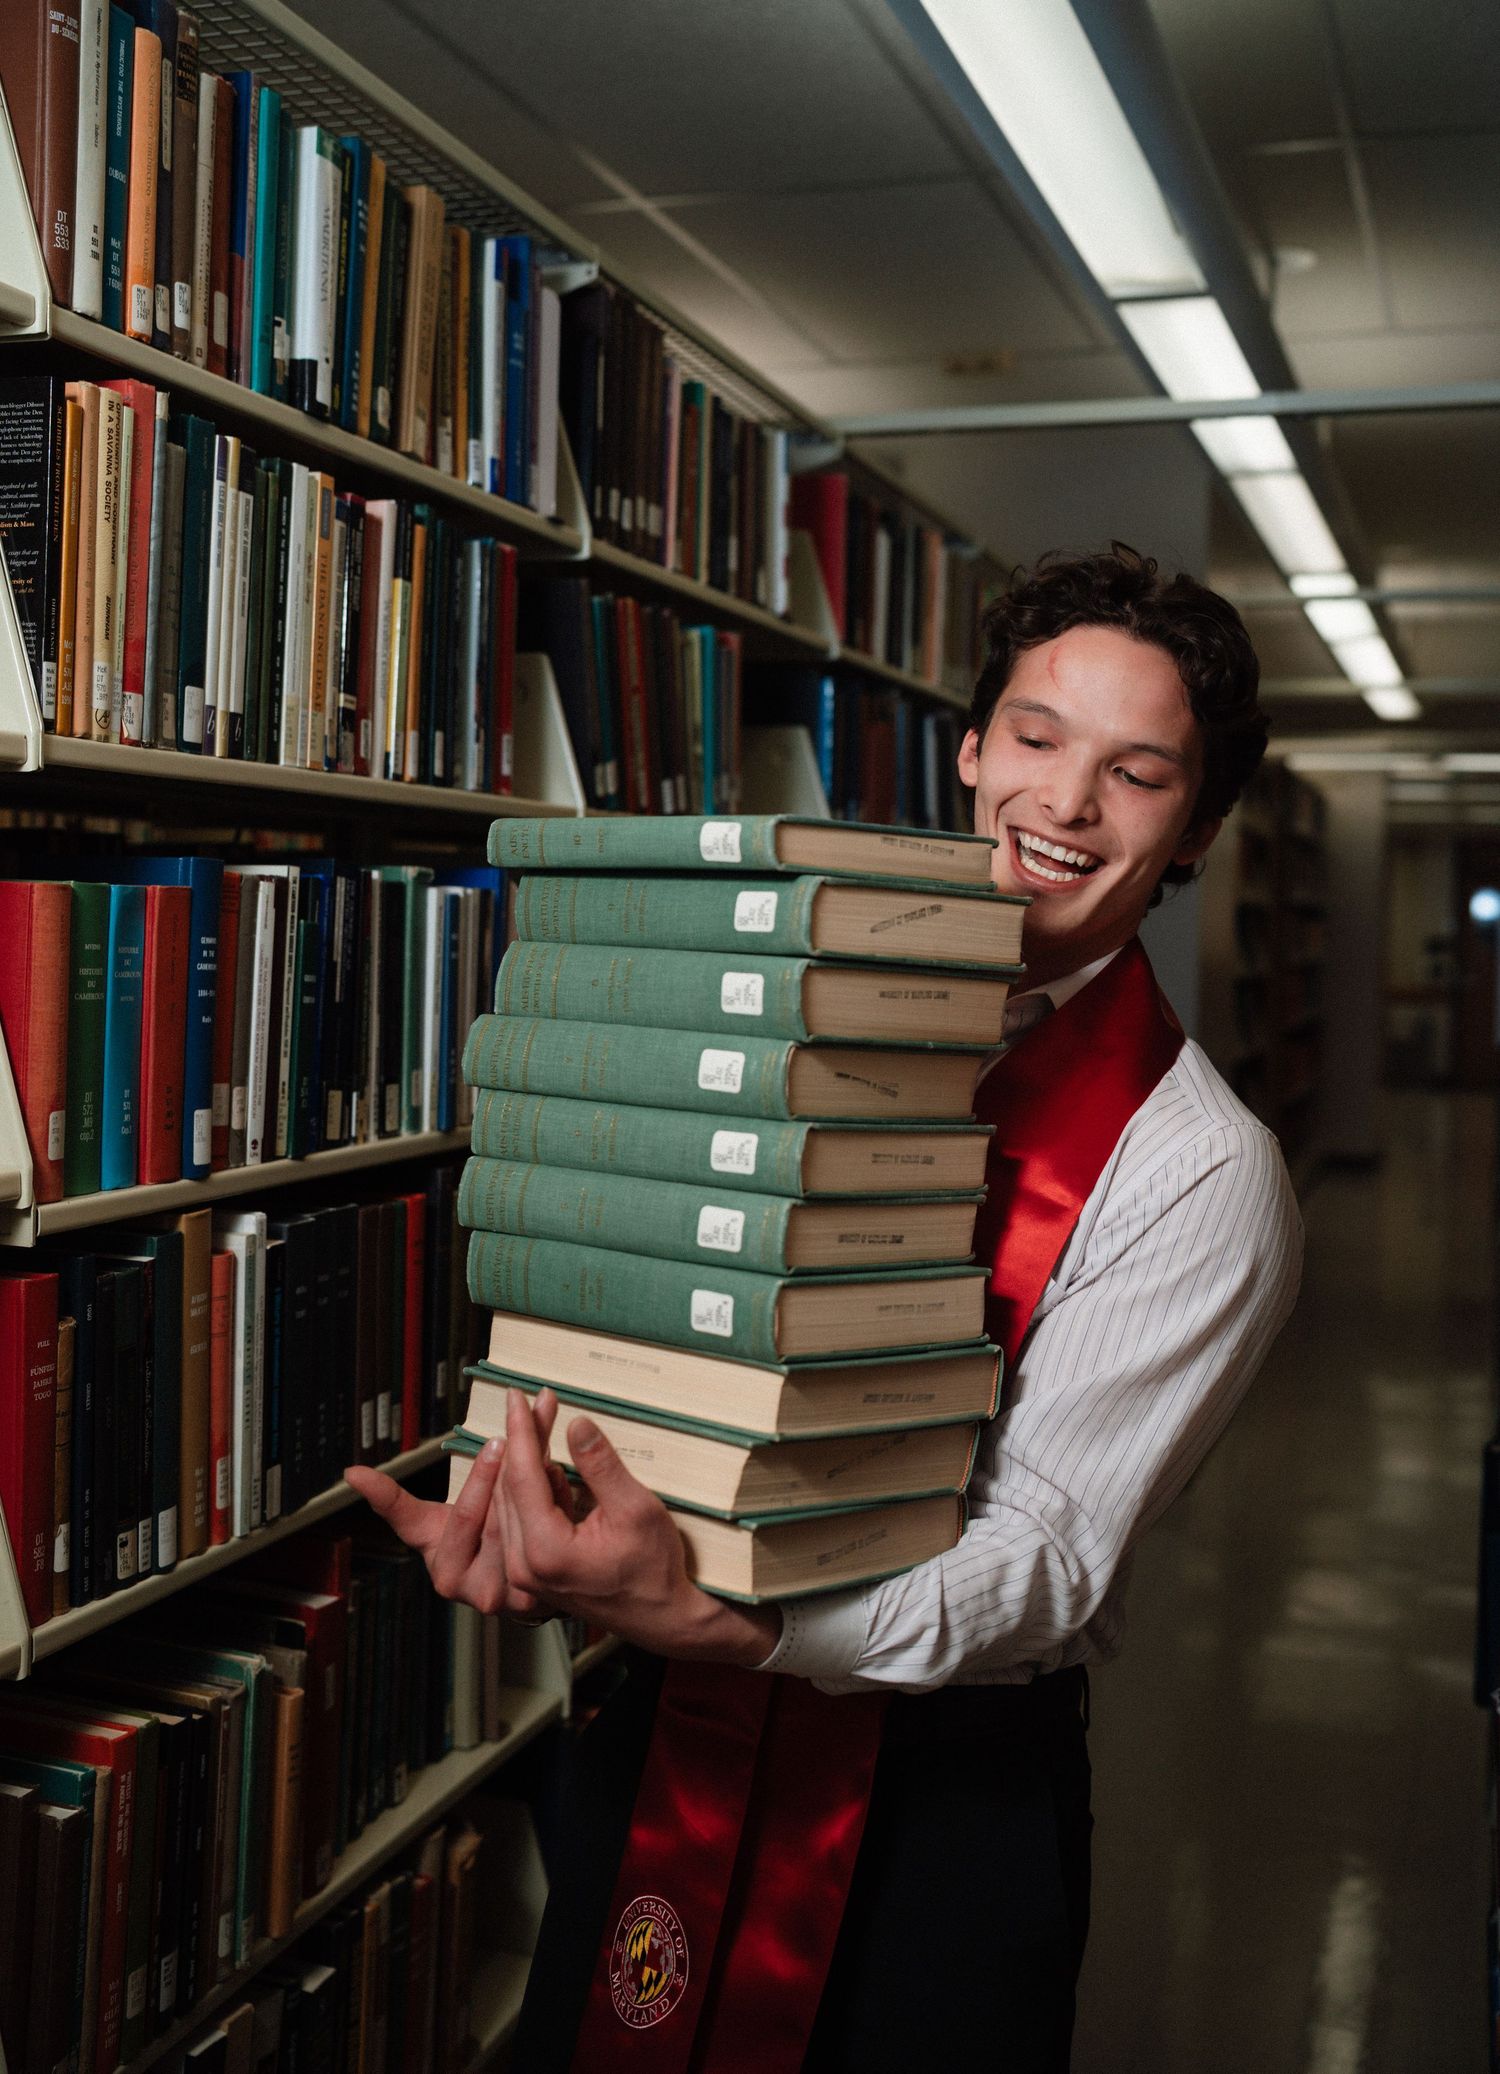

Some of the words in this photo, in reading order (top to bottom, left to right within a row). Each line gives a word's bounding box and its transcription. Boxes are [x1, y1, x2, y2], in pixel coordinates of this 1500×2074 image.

[57, 210, 68, 223] DT
[54, 223, 69, 237] 553
[53, 236, 70, 251] .S33
[107, 400, 115, 412] IN
[107, 415, 114, 423] A
[56, 404, 64, 461] SCRIBBLES
[113, 402, 122, 473] OPPORTUNITY
[105, 428, 114, 476] SAVANNA
[112, 474, 120, 500] AND
[104, 481, 112, 523] SOCIETY
[20, 519, 36, 527] Mass
[110, 501, 119, 566] CONSTRAINT
[319, 551, 329, 583] THE
[104, 595, 112, 641] BURNHAM
[316, 588, 327, 662] DANCING
[574, 834, 582, 847] 10
[79, 966, 104, 976] HISTOIRE
[87, 980, 97, 988] DU
[84, 1092, 93, 1104] DT
[82, 1104, 94, 1117] 572
[34, 1390, 52, 1401] TOGO
[118, 1785, 126, 1811] ANGOLA
[622, 1900, 679, 1932] UNIVERSITY
[674, 1937, 686, 1959] OF
[611, 1970, 671, 2024] MARYLAND
